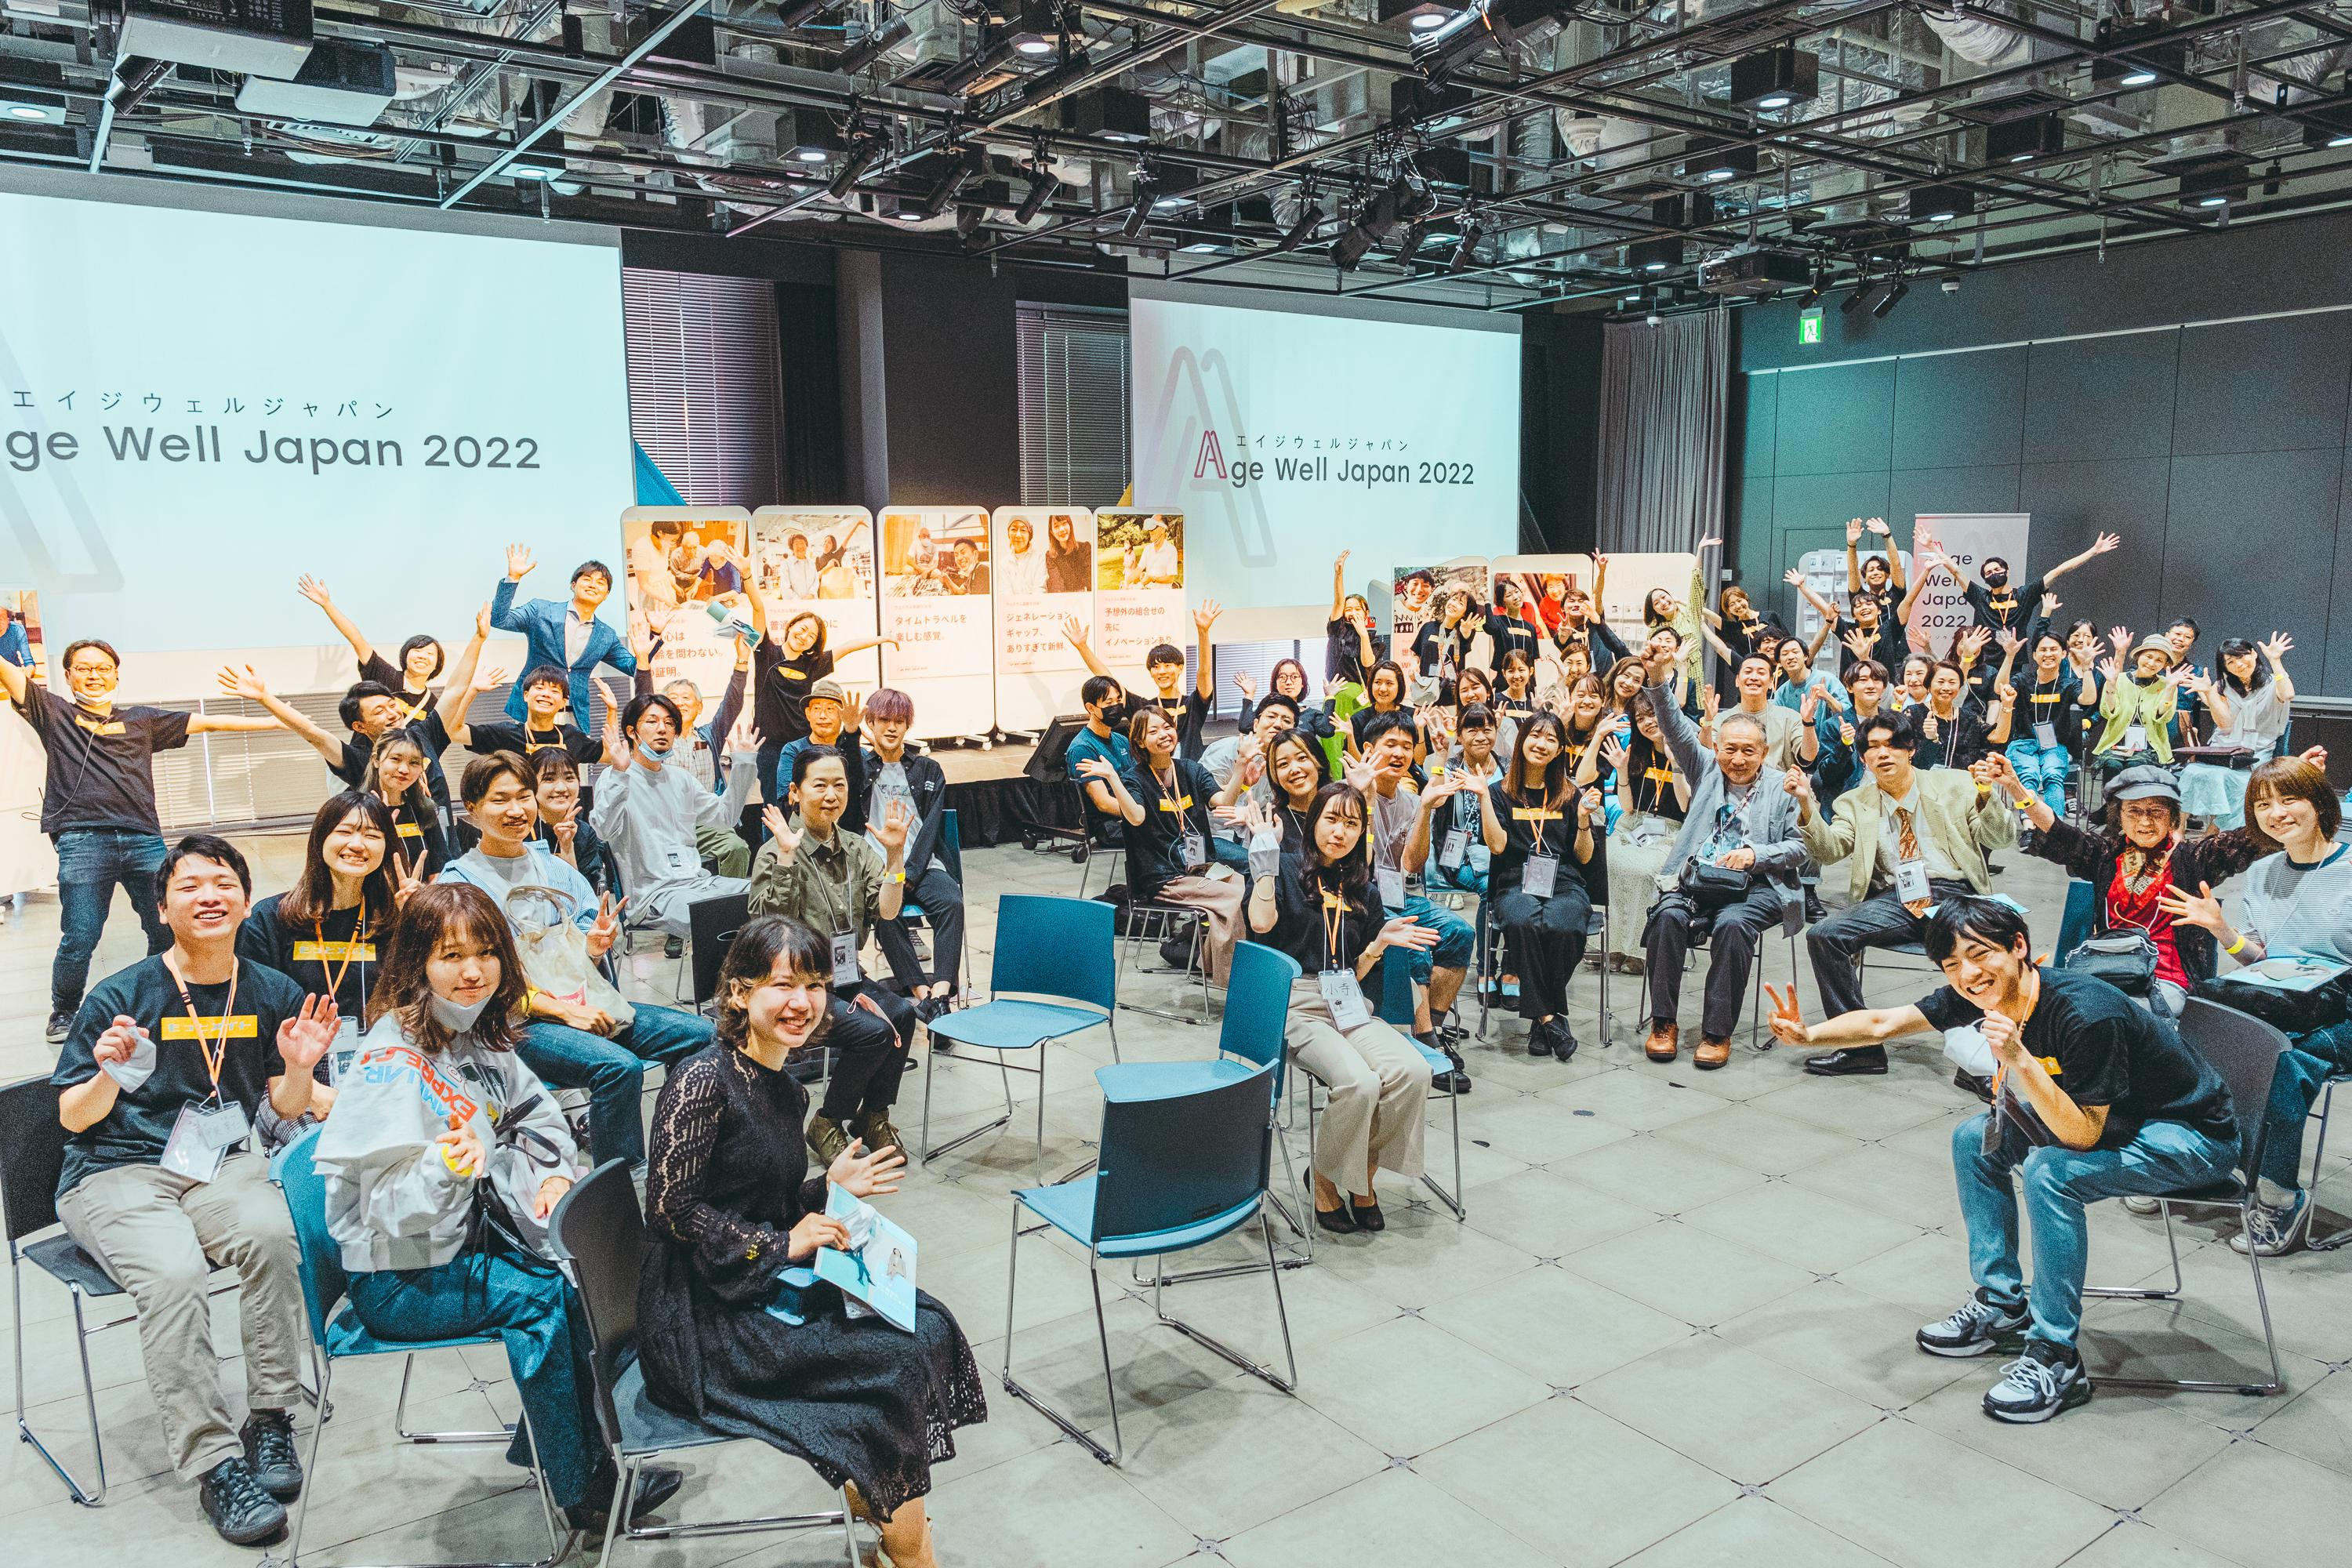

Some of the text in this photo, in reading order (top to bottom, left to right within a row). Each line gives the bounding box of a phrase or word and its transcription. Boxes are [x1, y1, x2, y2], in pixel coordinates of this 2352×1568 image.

[13, 390, 393, 419] エイジウェルジャパン
[102, 424, 221, 463] Well
[244, 430, 403, 476] Japan
[423, 434, 540, 469] 2022
[1236, 434, 1409, 452] エイジウェルジャパン
[1193, 430, 1474, 490] Age Well Japan 2022
[1922, 593, 1968, 609] Japa
[895, 614, 967, 626] タイムトラベルを
[1006, 612, 1072, 622] ジェネレーション
[1921, 615, 1967, 628] 2022
[1104, 622, 1121, 633] 先に
[1325, 982, 1356, 996] 小寺
[360, 1046, 479, 1123] EXPRE
